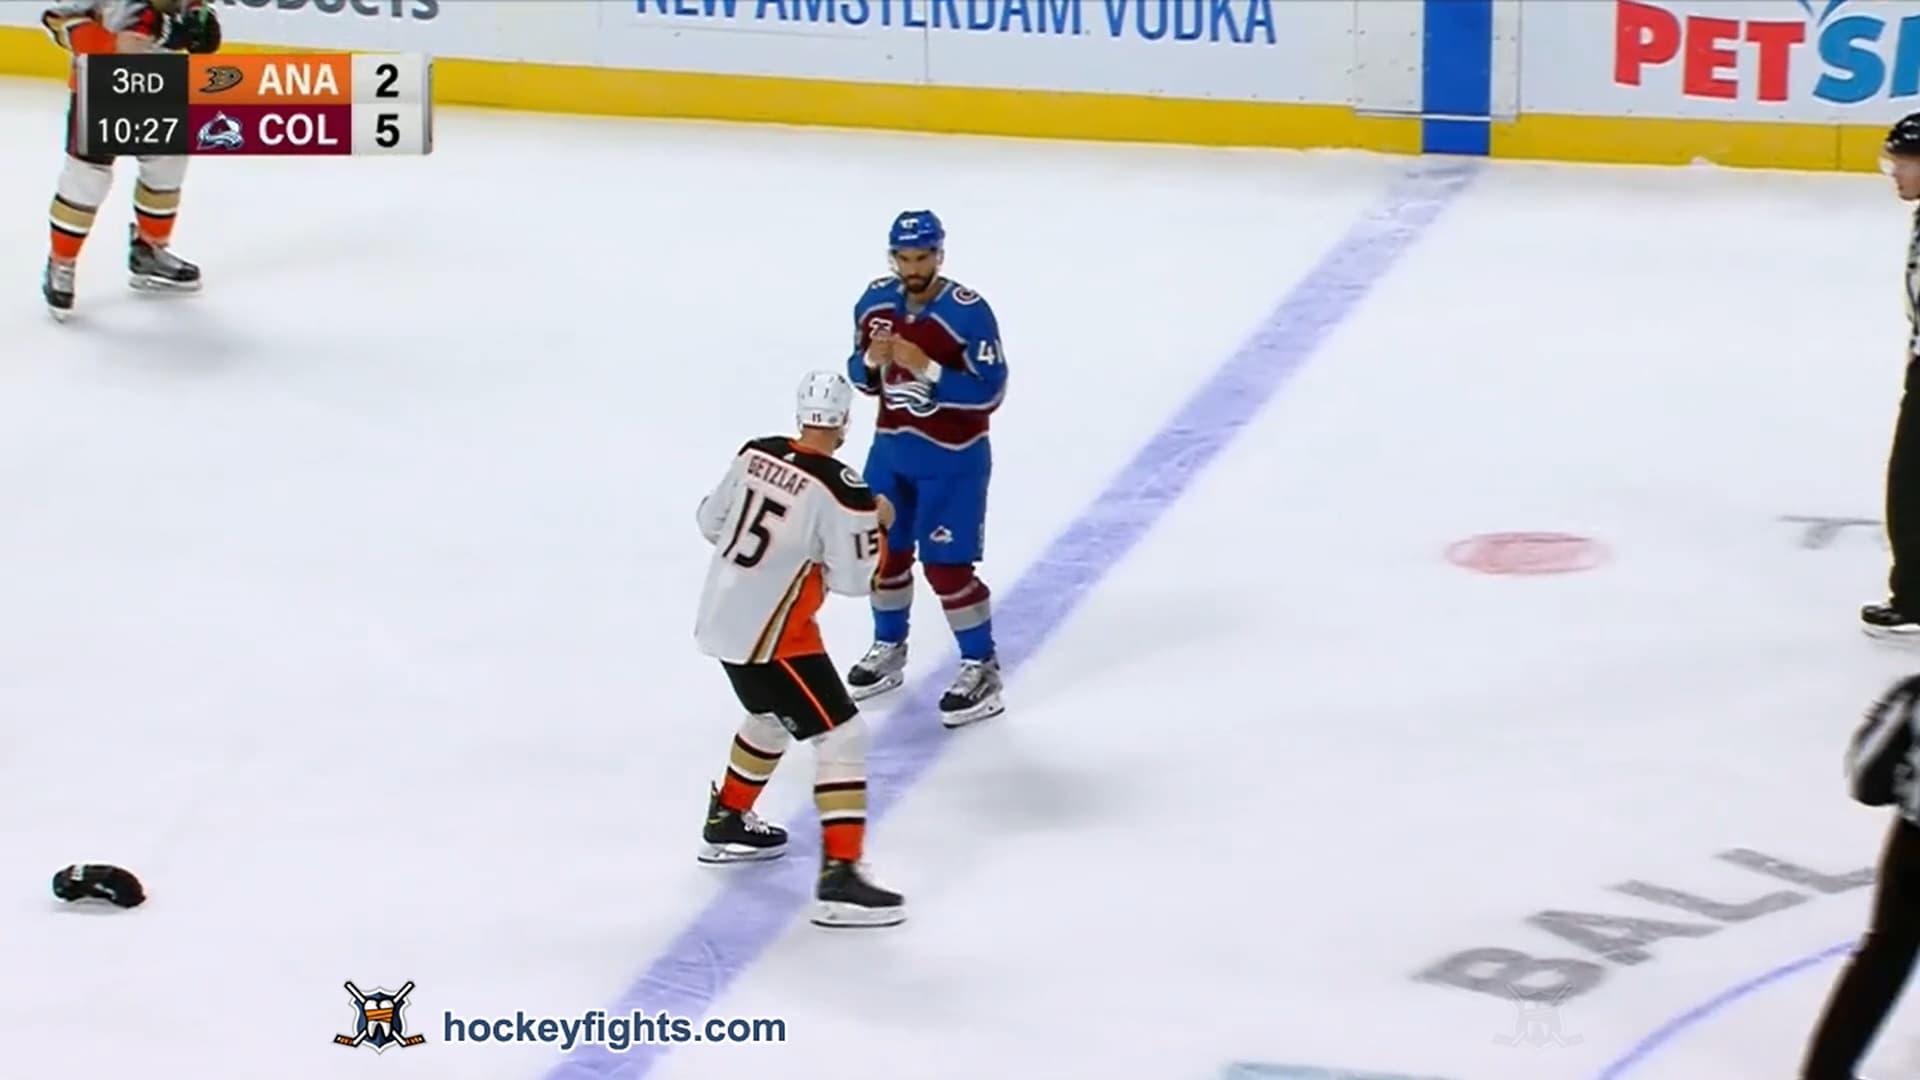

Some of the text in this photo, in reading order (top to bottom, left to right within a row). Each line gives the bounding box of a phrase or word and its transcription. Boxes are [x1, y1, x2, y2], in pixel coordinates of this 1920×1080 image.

[1103, 0, 1277, 44] VODKA
[748, 455, 809, 496] GETZLAF
[722, 487, 787, 568] 15
[853, 529, 880, 560] 15
